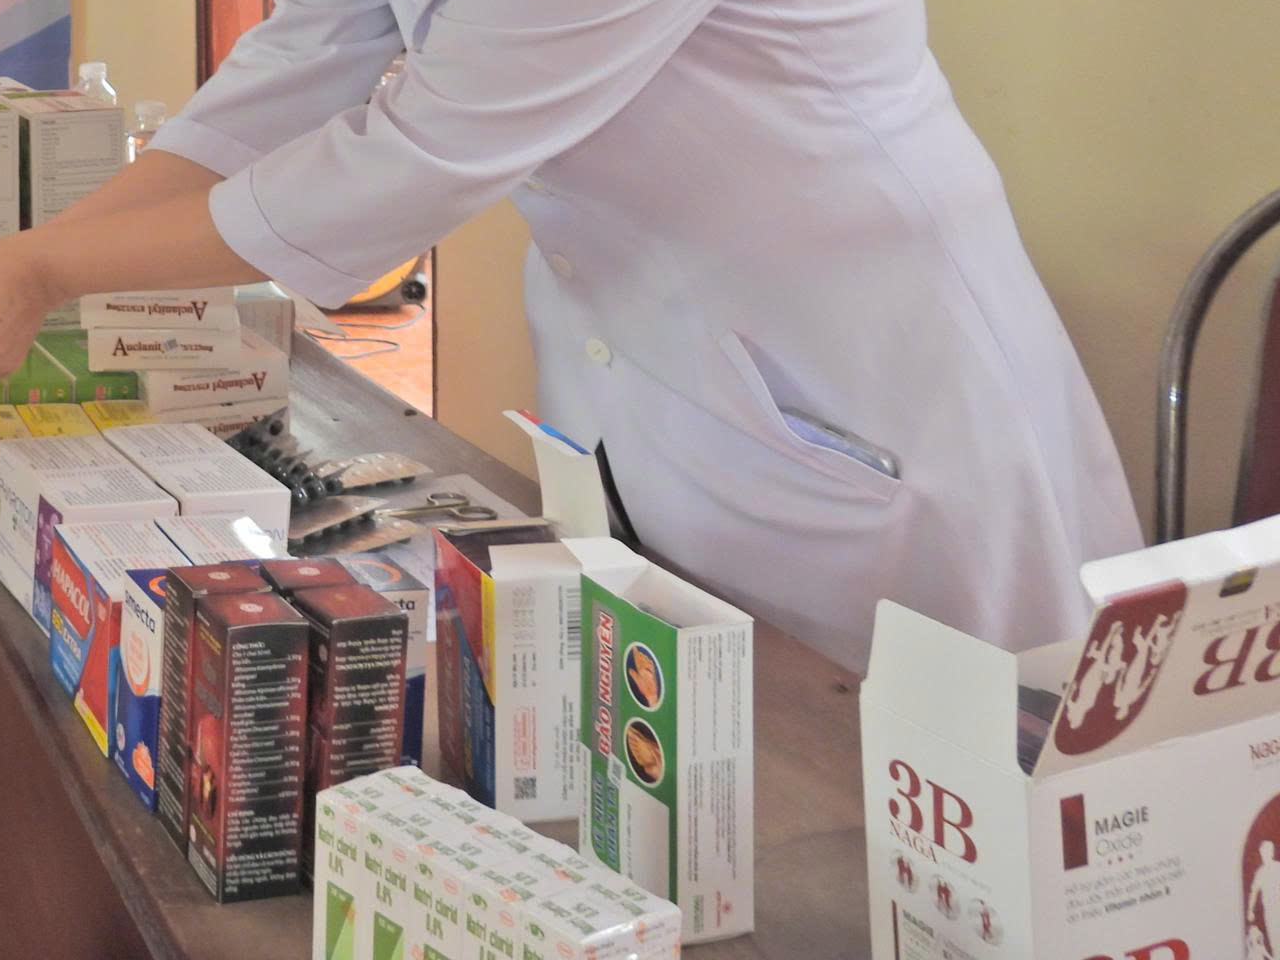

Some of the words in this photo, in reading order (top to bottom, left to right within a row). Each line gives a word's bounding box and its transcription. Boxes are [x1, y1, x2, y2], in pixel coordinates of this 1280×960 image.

[124, 589, 157, 634] smecta
[596, 610, 615, 705] NGUYÊN
[888, 759, 978, 864] 3B
[1094, 805, 1150, 836] MAGIE
